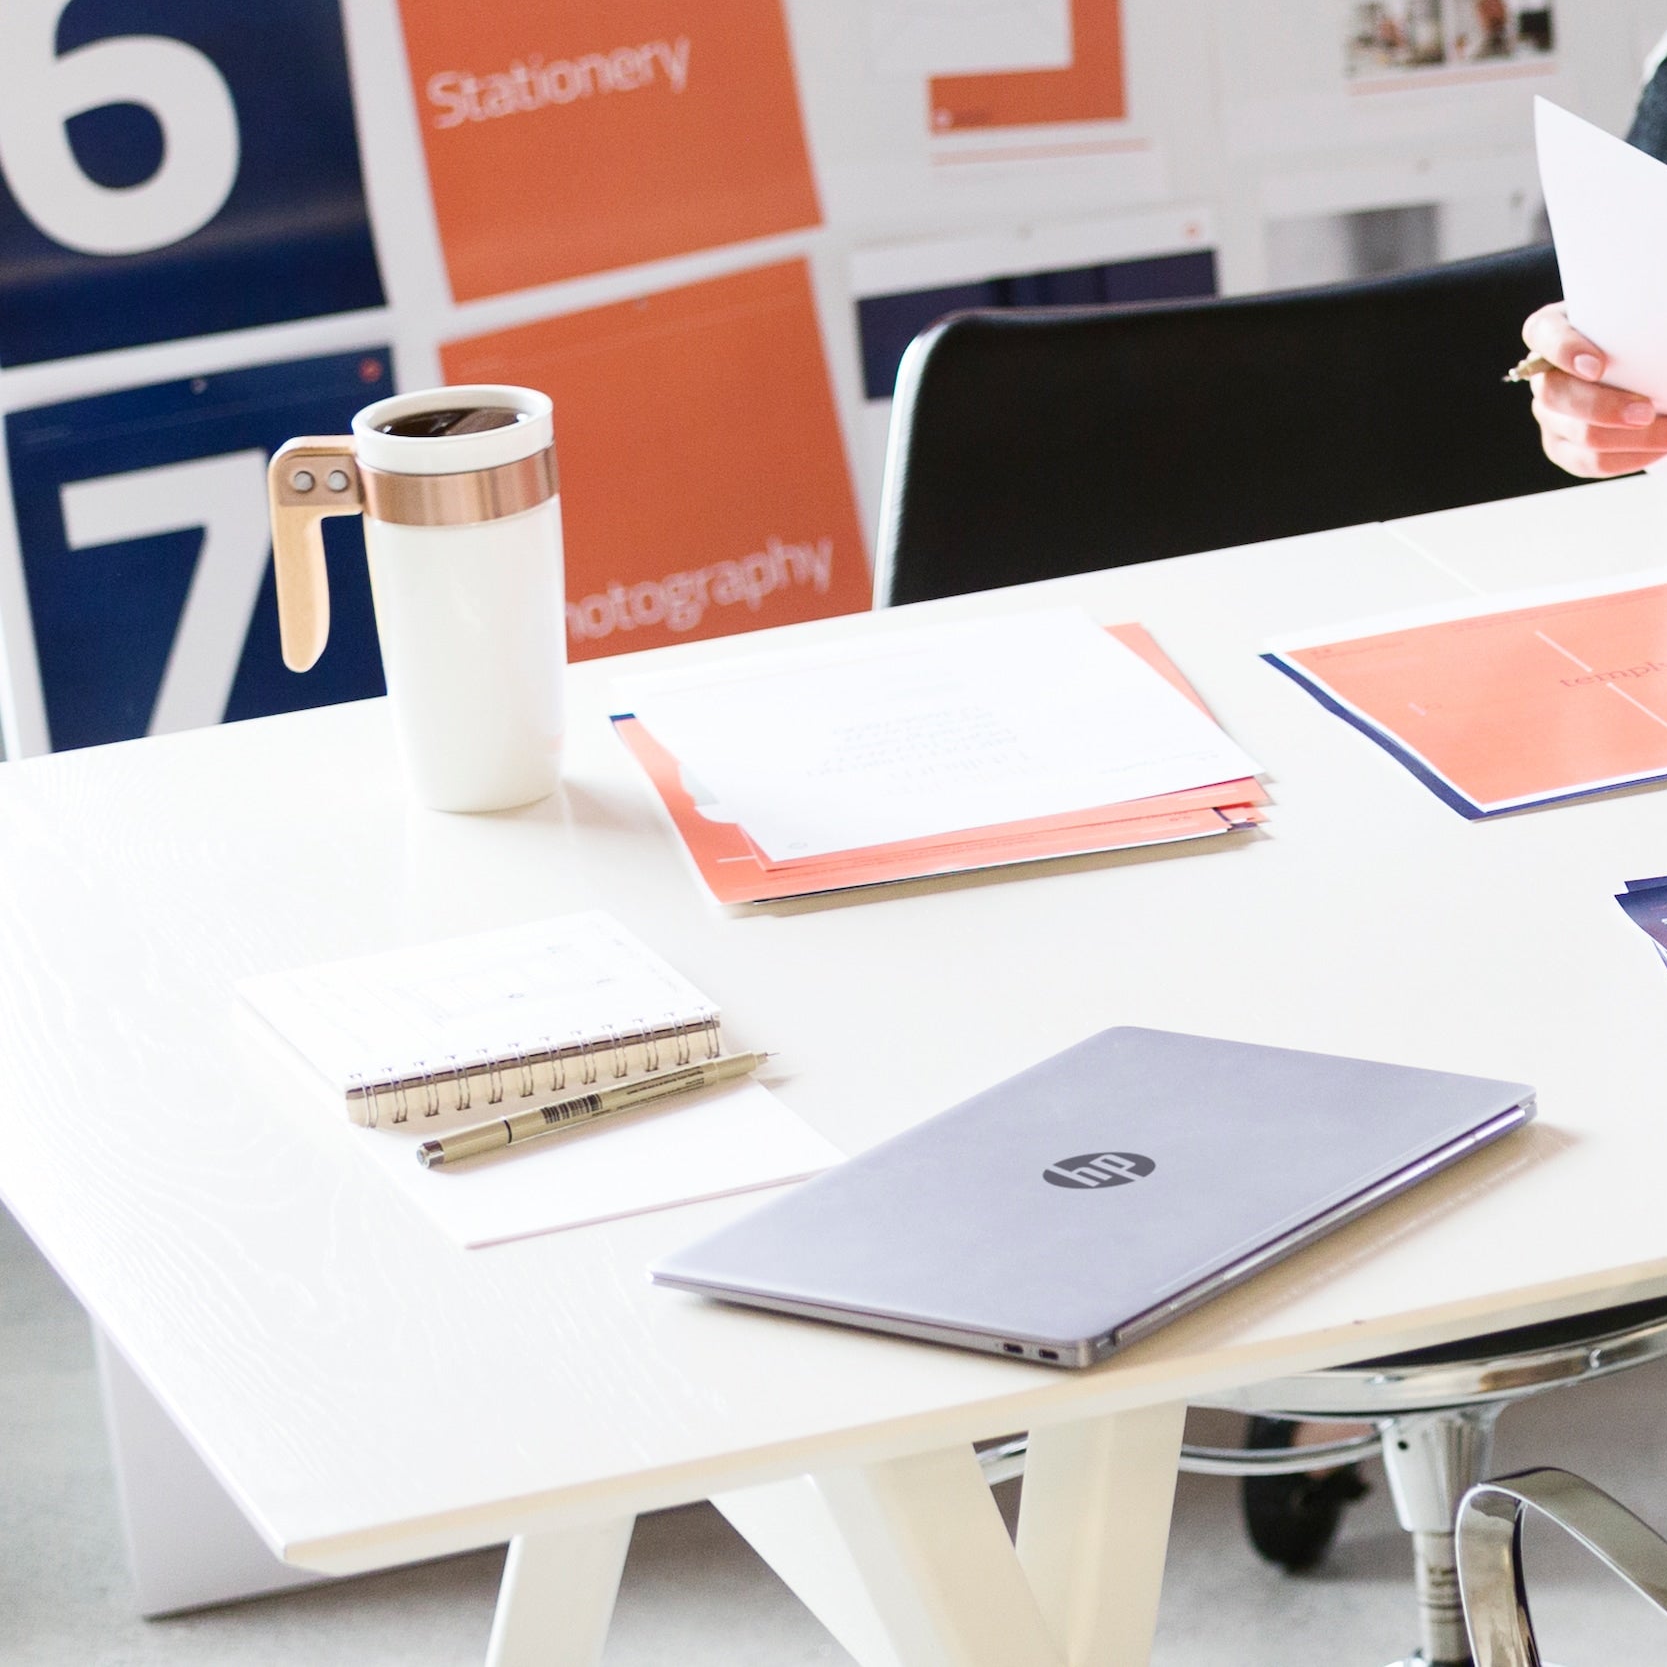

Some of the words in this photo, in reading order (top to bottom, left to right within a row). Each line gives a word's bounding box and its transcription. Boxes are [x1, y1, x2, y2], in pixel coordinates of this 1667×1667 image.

[426, 36, 690, 130] Stationery
[60, 448, 276, 740] 7
[566, 535, 833, 643] otography
[1043, 1152, 1152, 1189] hp
